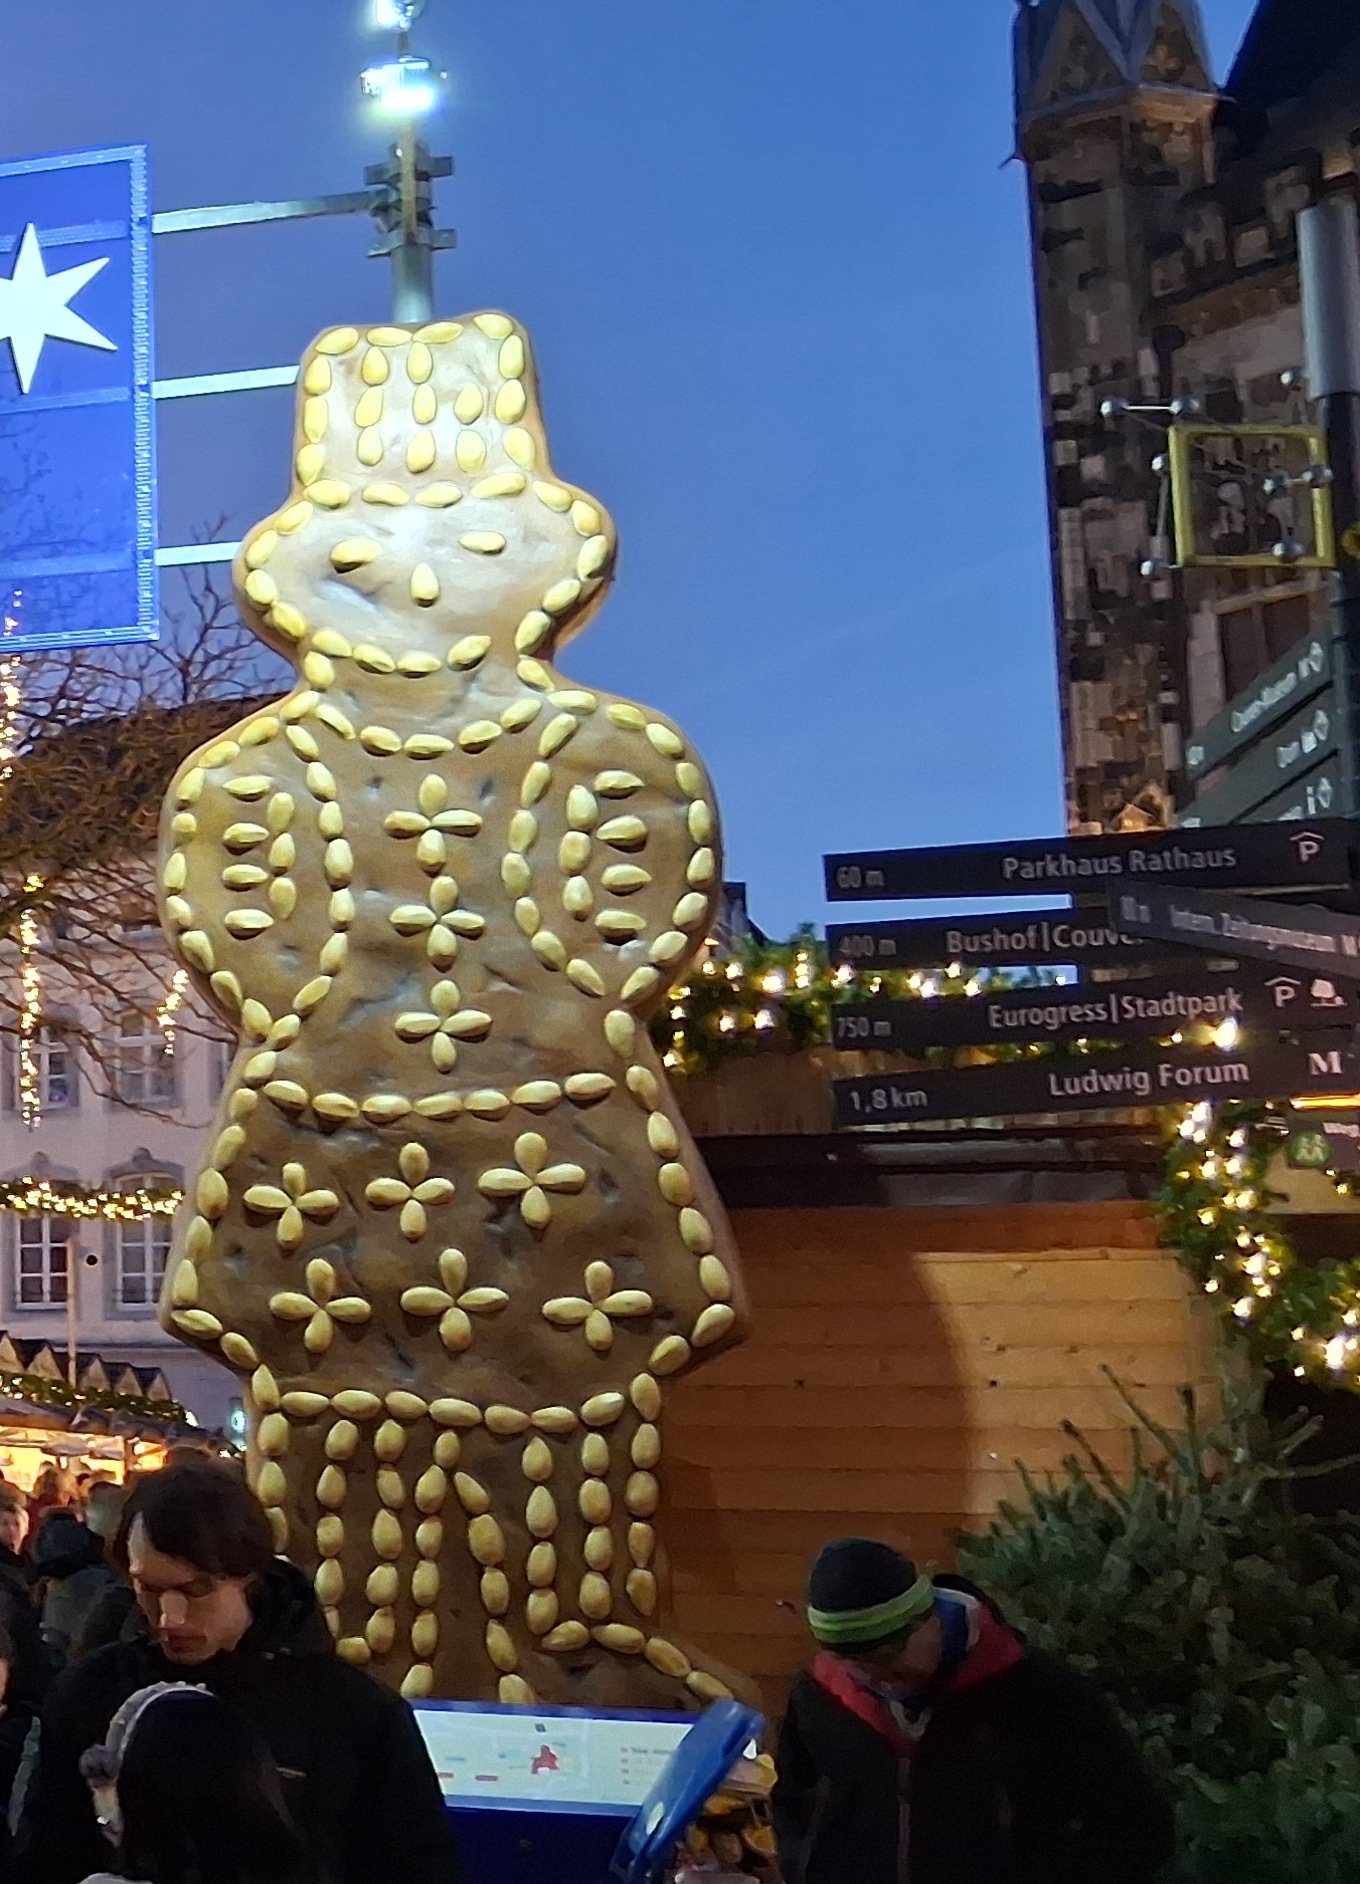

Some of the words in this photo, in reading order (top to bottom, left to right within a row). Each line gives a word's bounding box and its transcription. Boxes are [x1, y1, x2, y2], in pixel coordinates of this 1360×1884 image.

[865, 870, 886, 887] m
[1002, 852, 1123, 880] Parkhaus
[1129, 847, 1237, 872] Rathaus
[878, 938, 897, 955] m
[837, 1017, 870, 1038] 750
[873, 1019, 892, 1037] m
[849, 1089, 888, 1114] 1,8
[891, 1086, 928, 1108] km
[1049, 1067, 1150, 1097] Ludwig
[1158, 1061, 1250, 1088] Forum
